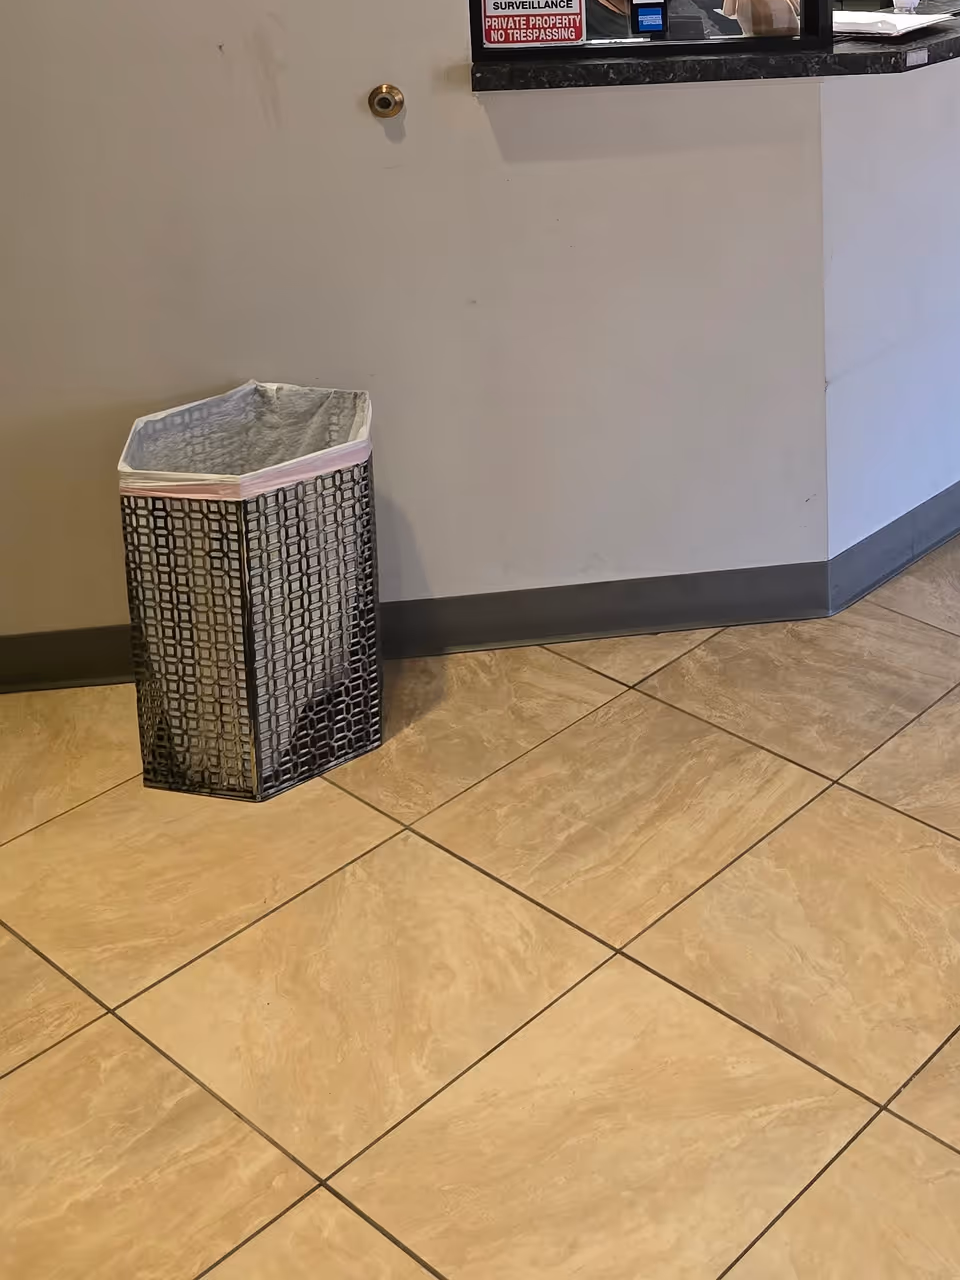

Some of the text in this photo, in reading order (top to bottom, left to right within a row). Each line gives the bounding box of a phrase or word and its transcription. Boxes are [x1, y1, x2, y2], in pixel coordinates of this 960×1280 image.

[493, 0, 573, 10] SURVEILLANCE
[485, 14, 581, 30] PRIVATE PROPERTY
[491, 28, 576, 42] NO TRESPASSING
